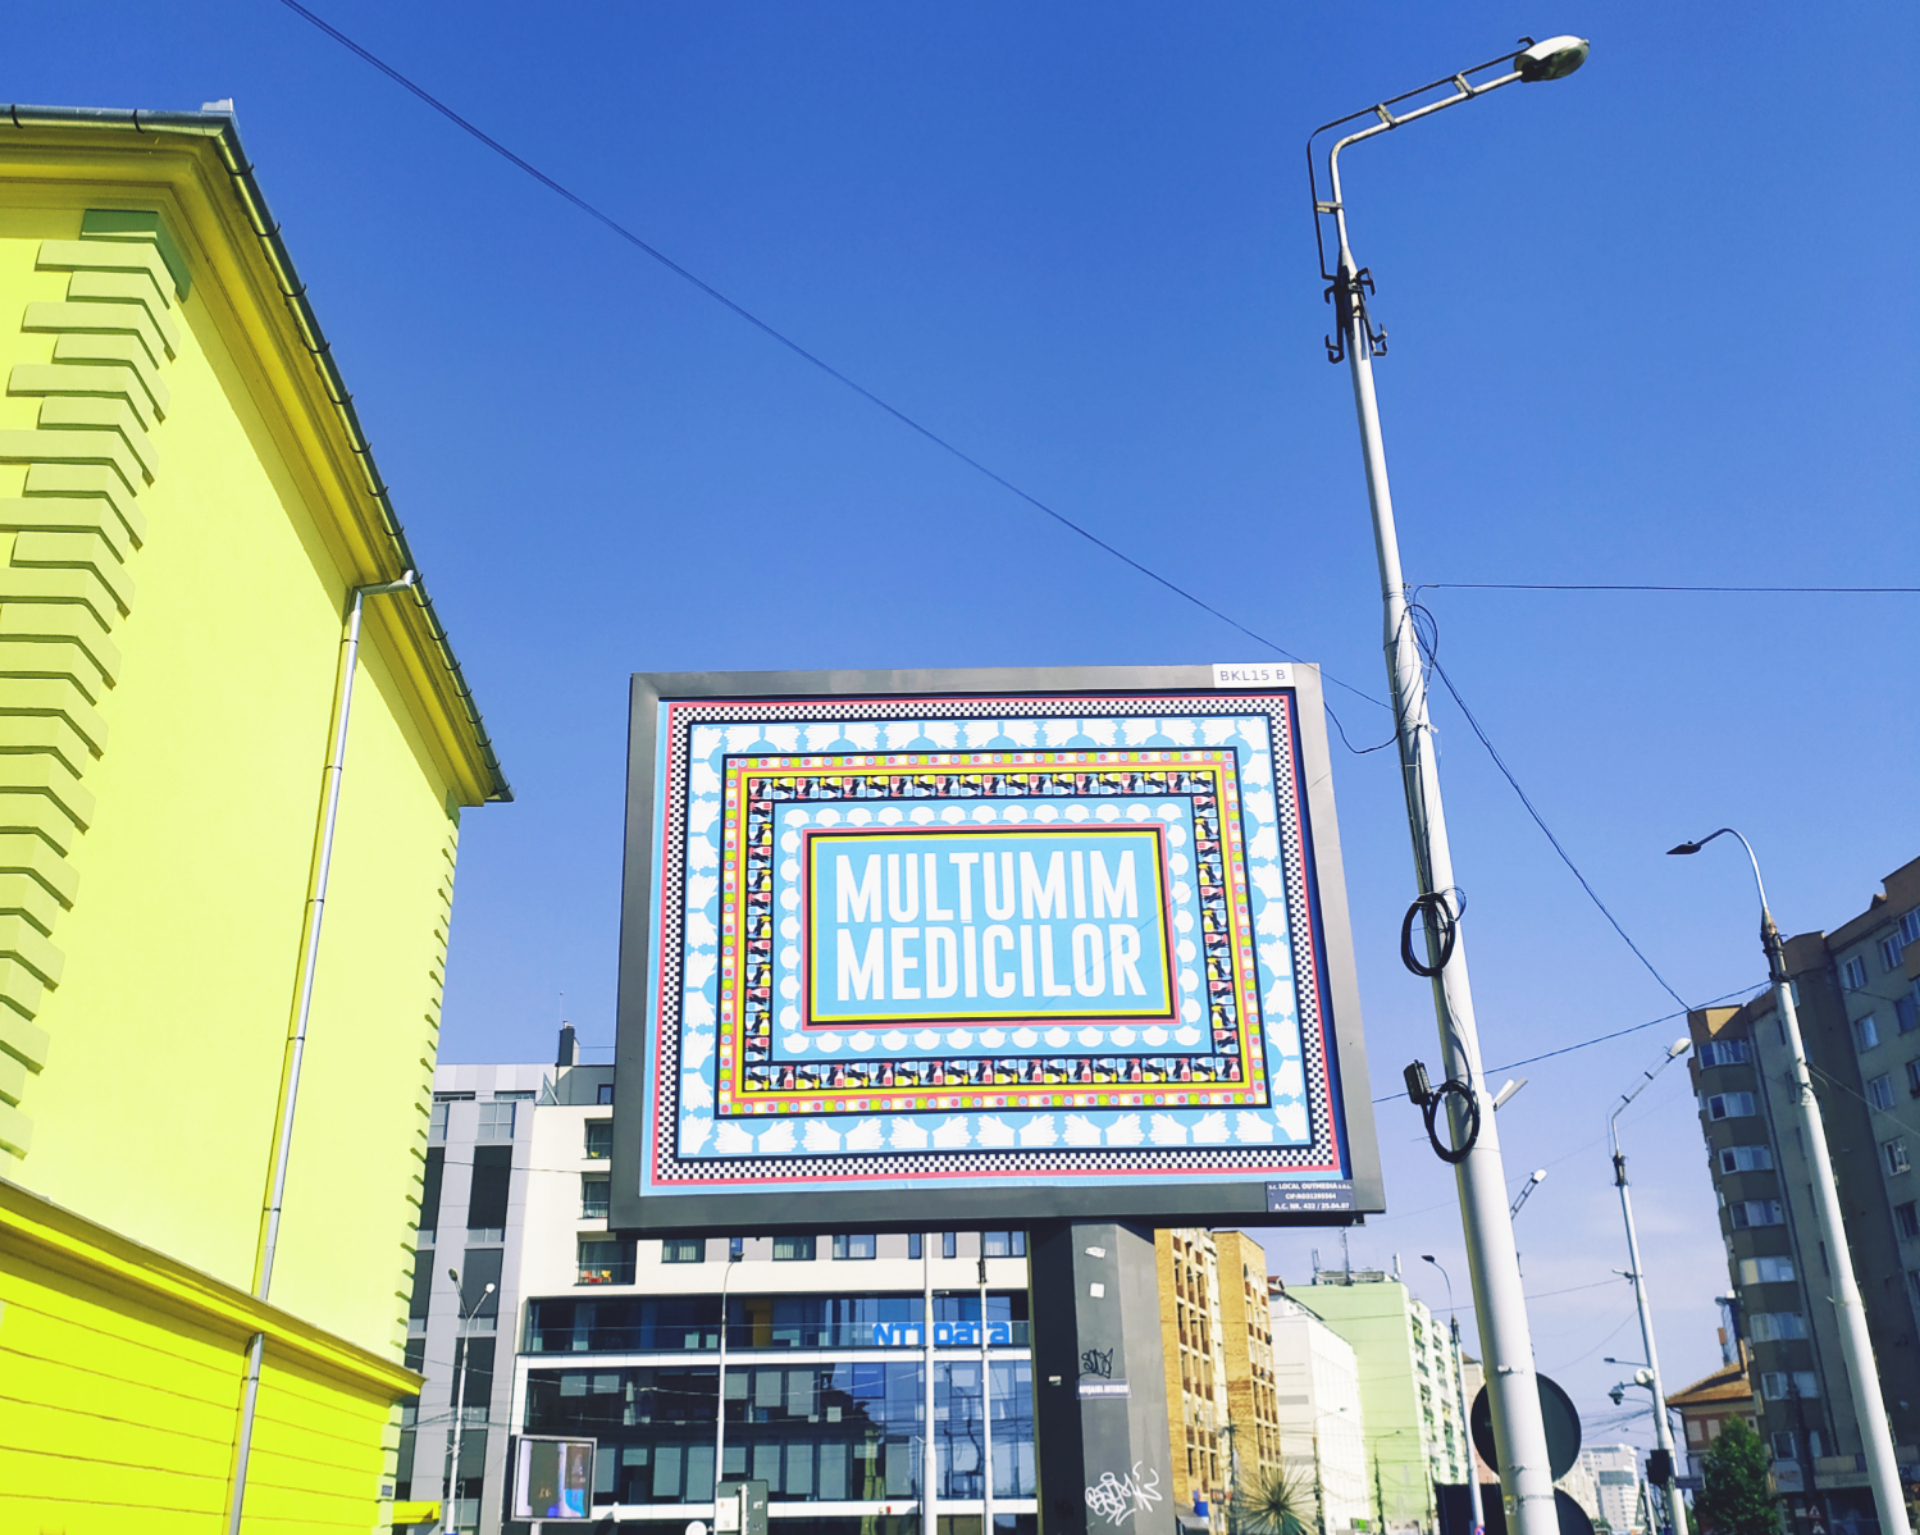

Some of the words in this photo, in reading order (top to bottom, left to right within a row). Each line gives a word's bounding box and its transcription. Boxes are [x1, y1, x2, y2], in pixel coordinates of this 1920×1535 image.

[1220, 669, 1270, 682] BKL15
[1276, 669, 1286, 681] B
[837, 923, 1147, 1001] MEDICILOR
[874, 1322, 925, 1345] NTT
